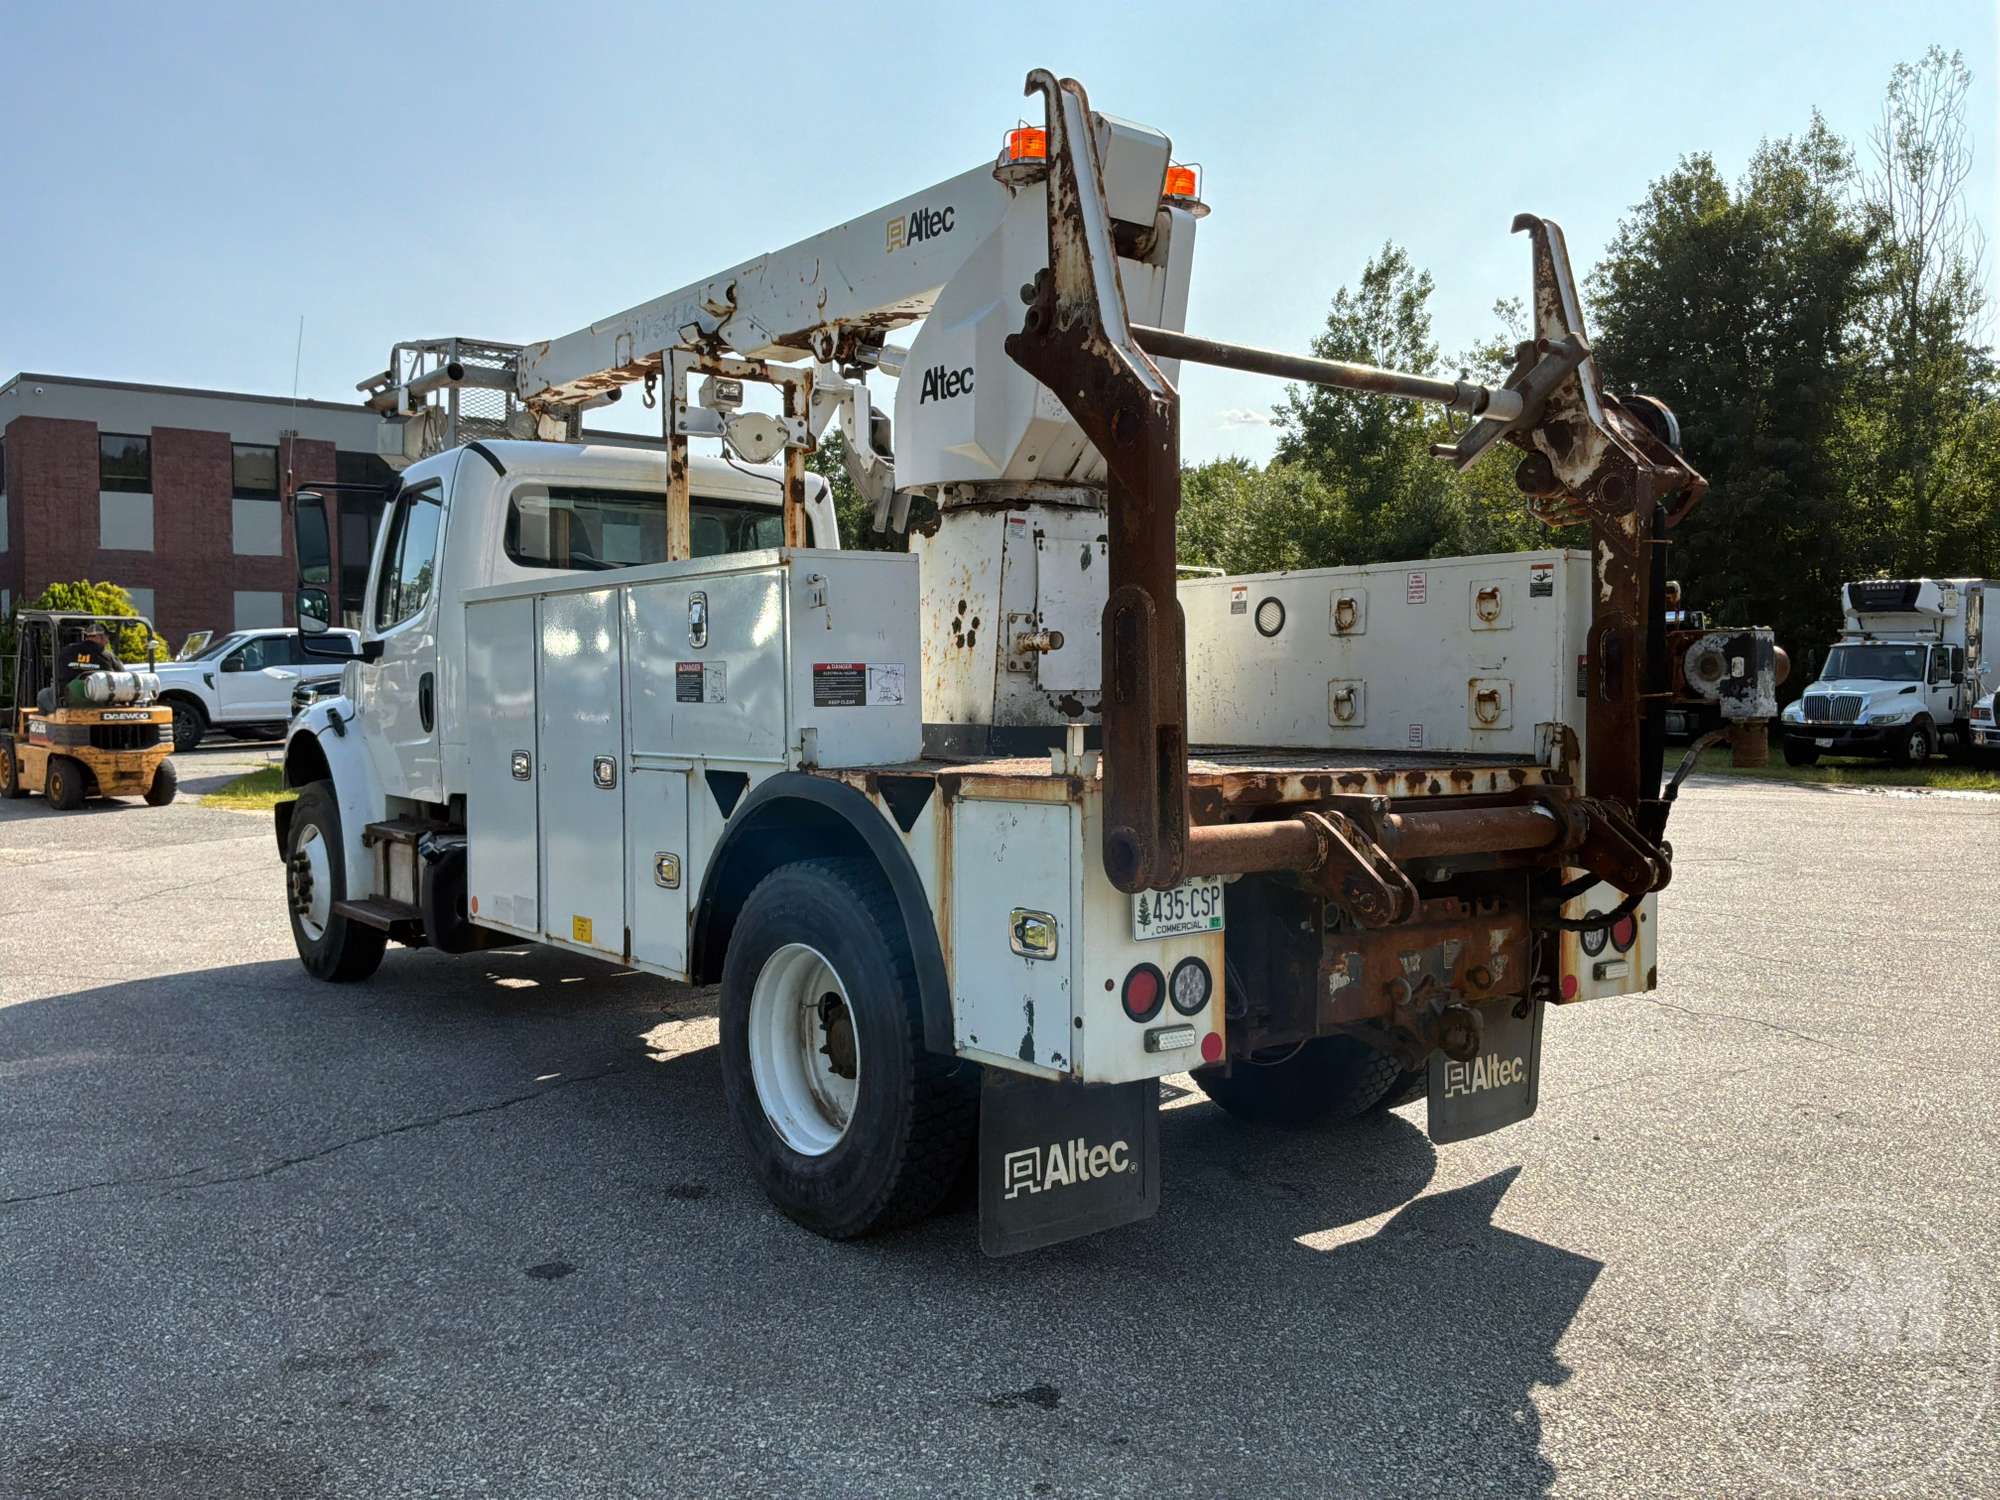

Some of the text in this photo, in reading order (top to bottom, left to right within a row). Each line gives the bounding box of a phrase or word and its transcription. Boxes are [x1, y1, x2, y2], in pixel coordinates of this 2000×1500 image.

[906, 206, 955, 247] Altec
[920, 364, 974, 405] Altec
[103, 712, 149, 720] DAEWOO
[1156, 921, 1202, 934] COMMERCIAL
[1471, 1053, 1523, 1094] Altec
[1043, 1137, 1129, 1191] Altec
